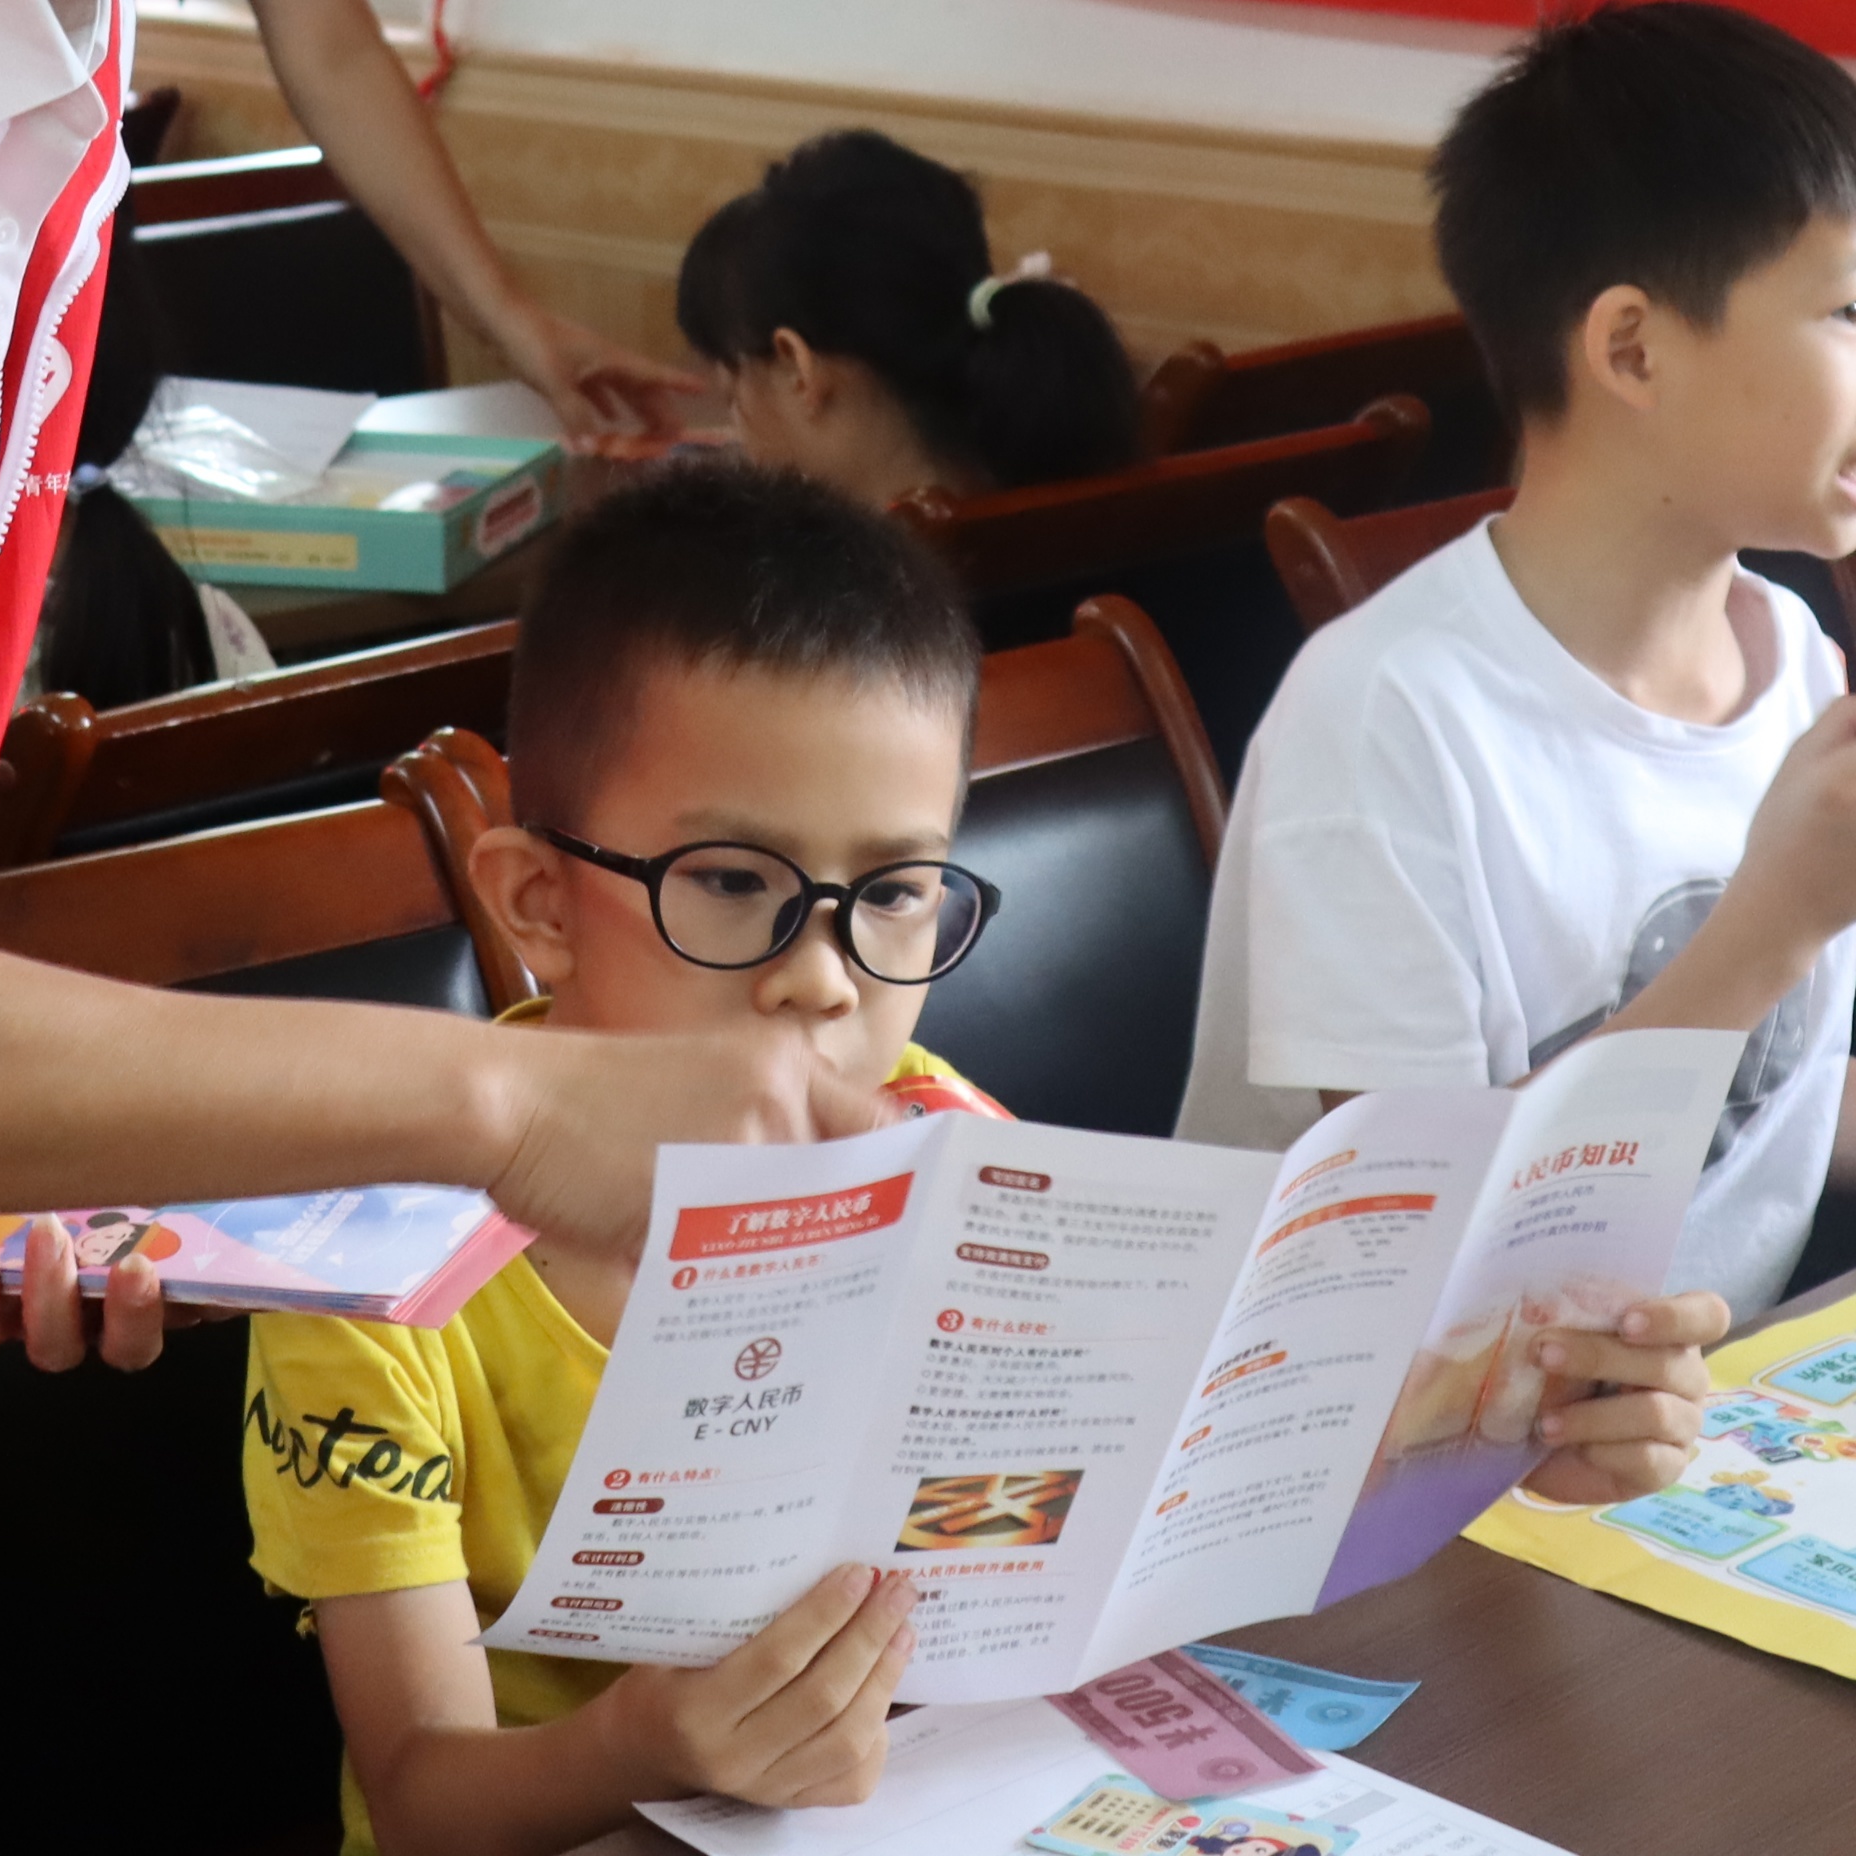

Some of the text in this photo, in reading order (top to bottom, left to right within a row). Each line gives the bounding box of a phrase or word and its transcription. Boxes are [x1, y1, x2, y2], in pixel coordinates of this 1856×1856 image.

[729, 1193, 872, 1235] 了解数字人民币
[682, 1383, 805, 1419] 数字人民币
